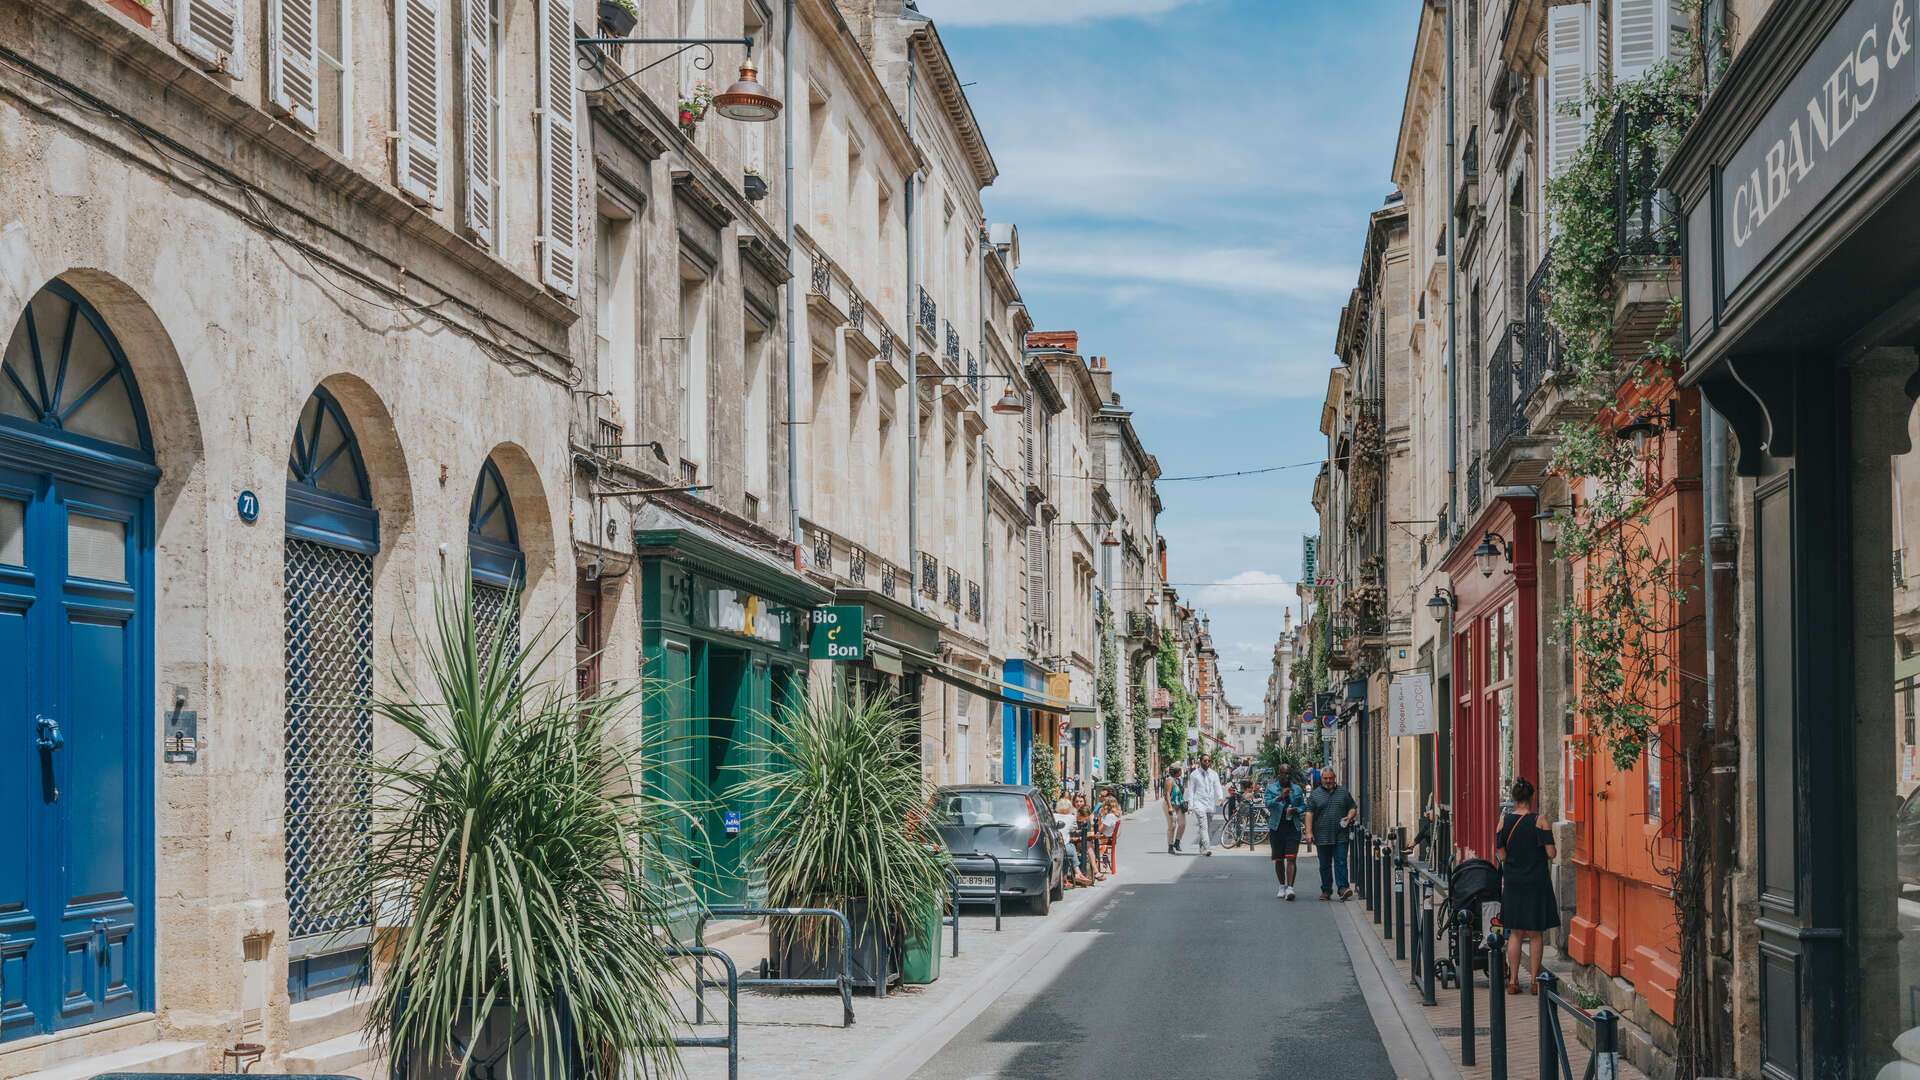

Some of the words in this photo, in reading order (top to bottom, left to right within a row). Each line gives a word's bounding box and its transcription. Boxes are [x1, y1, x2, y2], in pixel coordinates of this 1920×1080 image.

[1733, 23, 1879, 248] CABANES
[1887, 0, 1911, 69] &
[244, 496, 254, 514] 71
[812, 610, 837, 623] Bio
[828, 643, 858, 656] Bon
